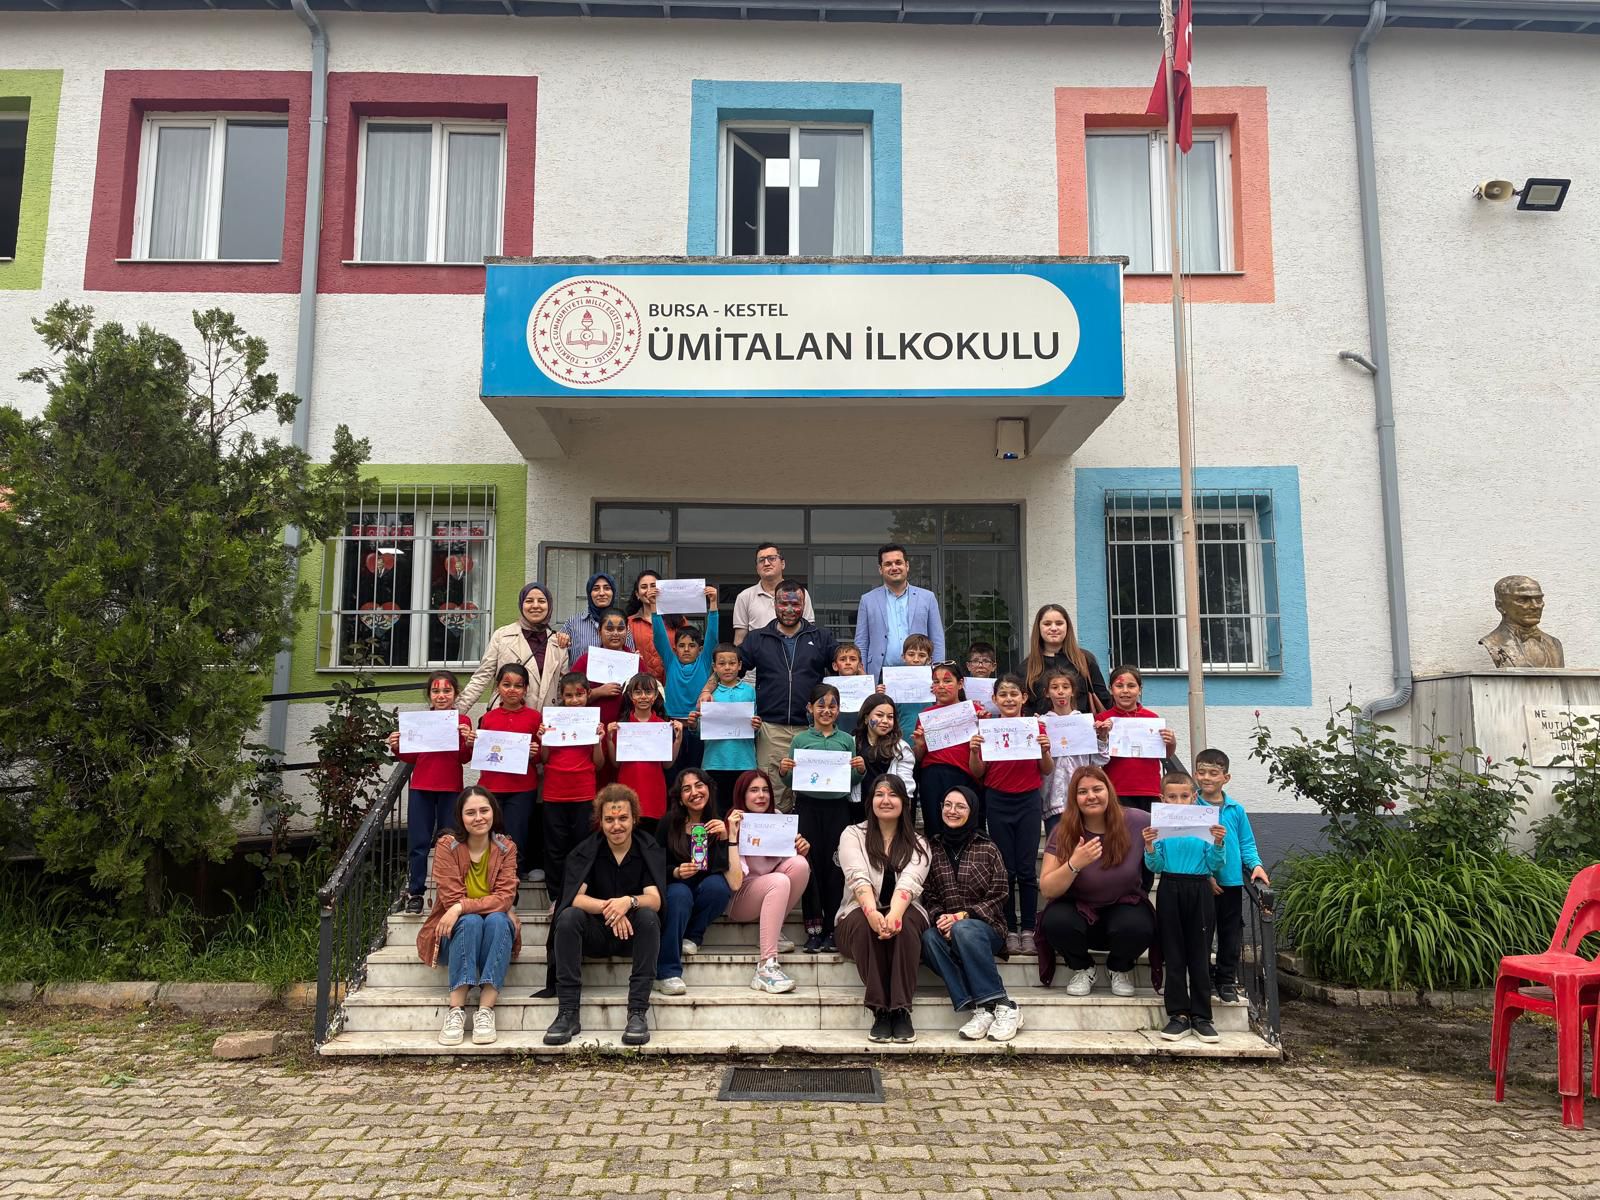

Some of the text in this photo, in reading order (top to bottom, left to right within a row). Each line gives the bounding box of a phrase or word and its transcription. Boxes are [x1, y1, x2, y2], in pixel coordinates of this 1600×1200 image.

[649, 303, 709, 317] BURSA
[724, 303, 789, 317] KESTEL
[552, 298, 622, 365] TÜRKİYE CUMHURİYETİ MİLLİ EĞİTİM BAKANLIĞI
[648, 325, 1059, 361] ÜMİTALAN İLKOKULU
[1534, 709, 1547, 718] NE
